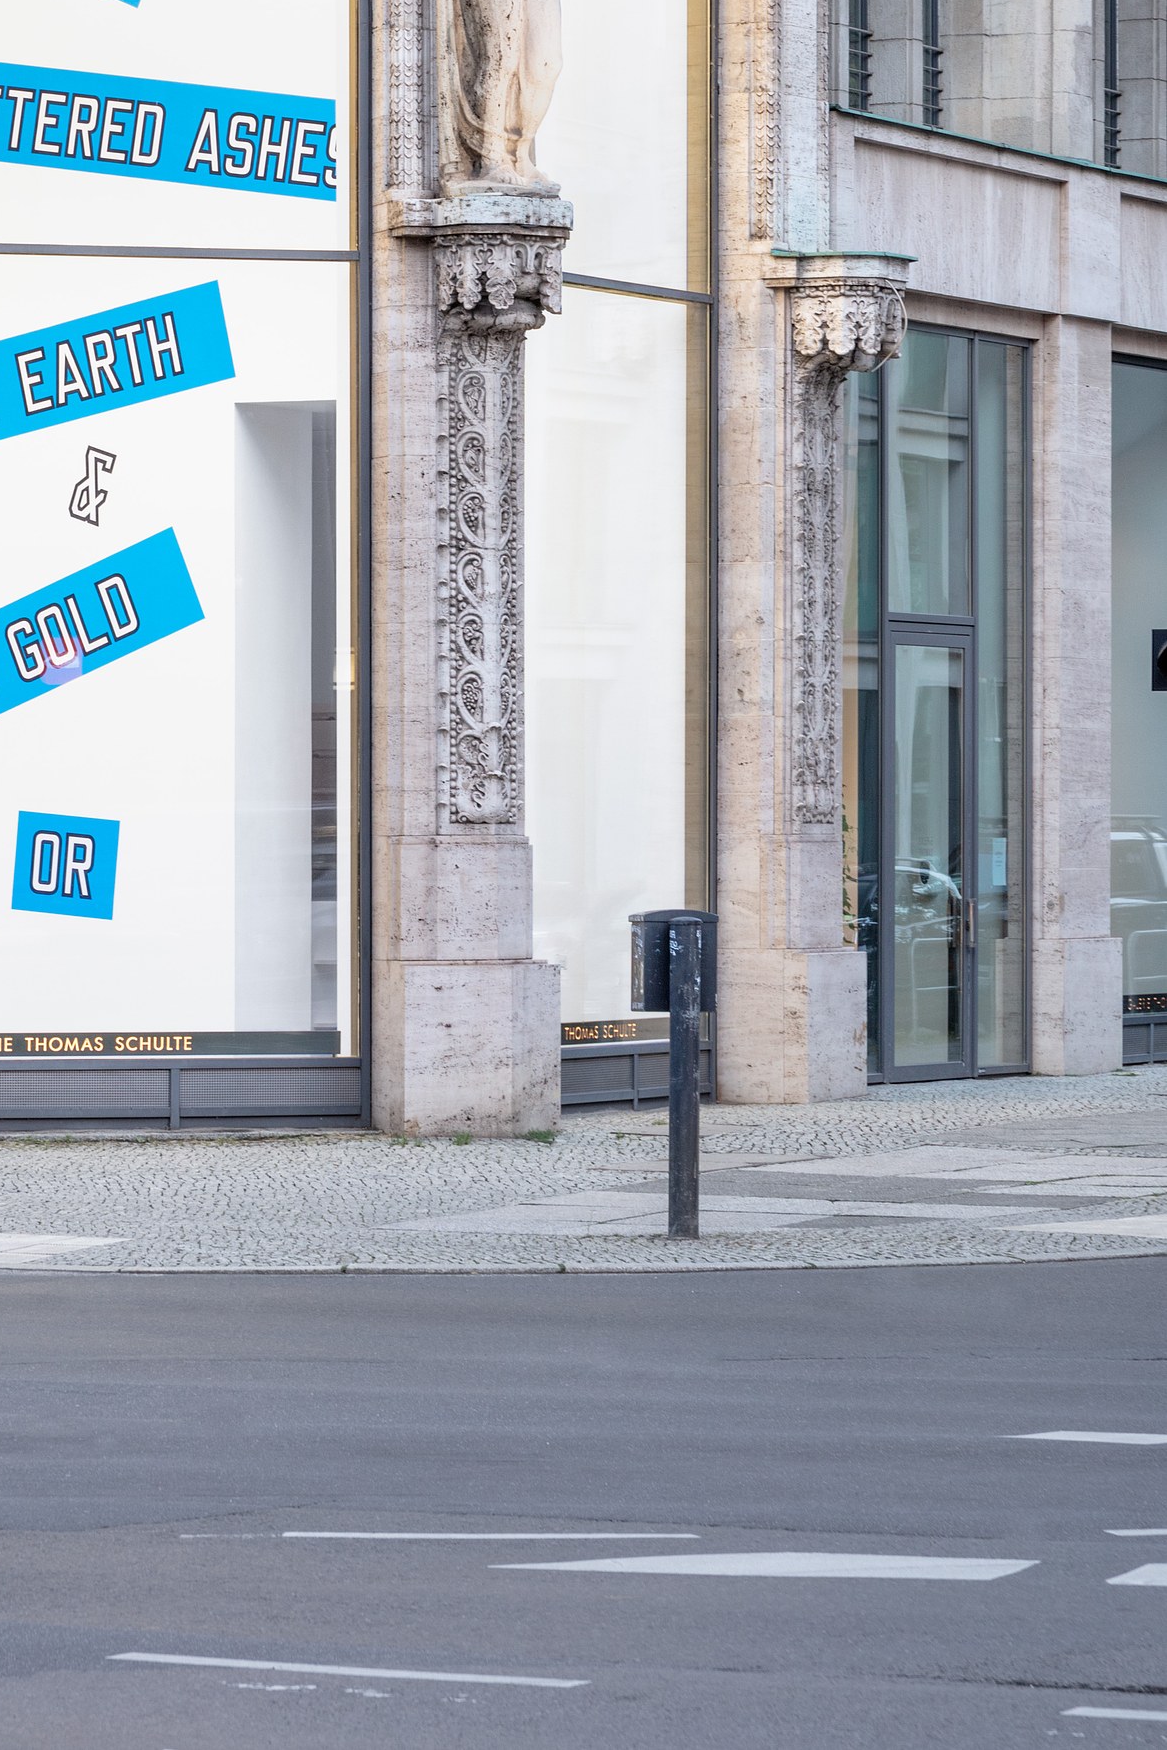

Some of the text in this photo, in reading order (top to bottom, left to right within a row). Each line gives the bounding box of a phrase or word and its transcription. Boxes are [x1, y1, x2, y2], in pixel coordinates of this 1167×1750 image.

[14, 311, 185, 416] EARTH
[68, 445, 117, 527] &
[5, 573, 140, 683] GOLD
[30, 830, 96, 900] OR
[25, 1036, 104, 1052] THOMAS
[115, 1036, 193, 1052] SCHULTE
[564, 1023, 637, 1040] THOMAS SCHULTE
